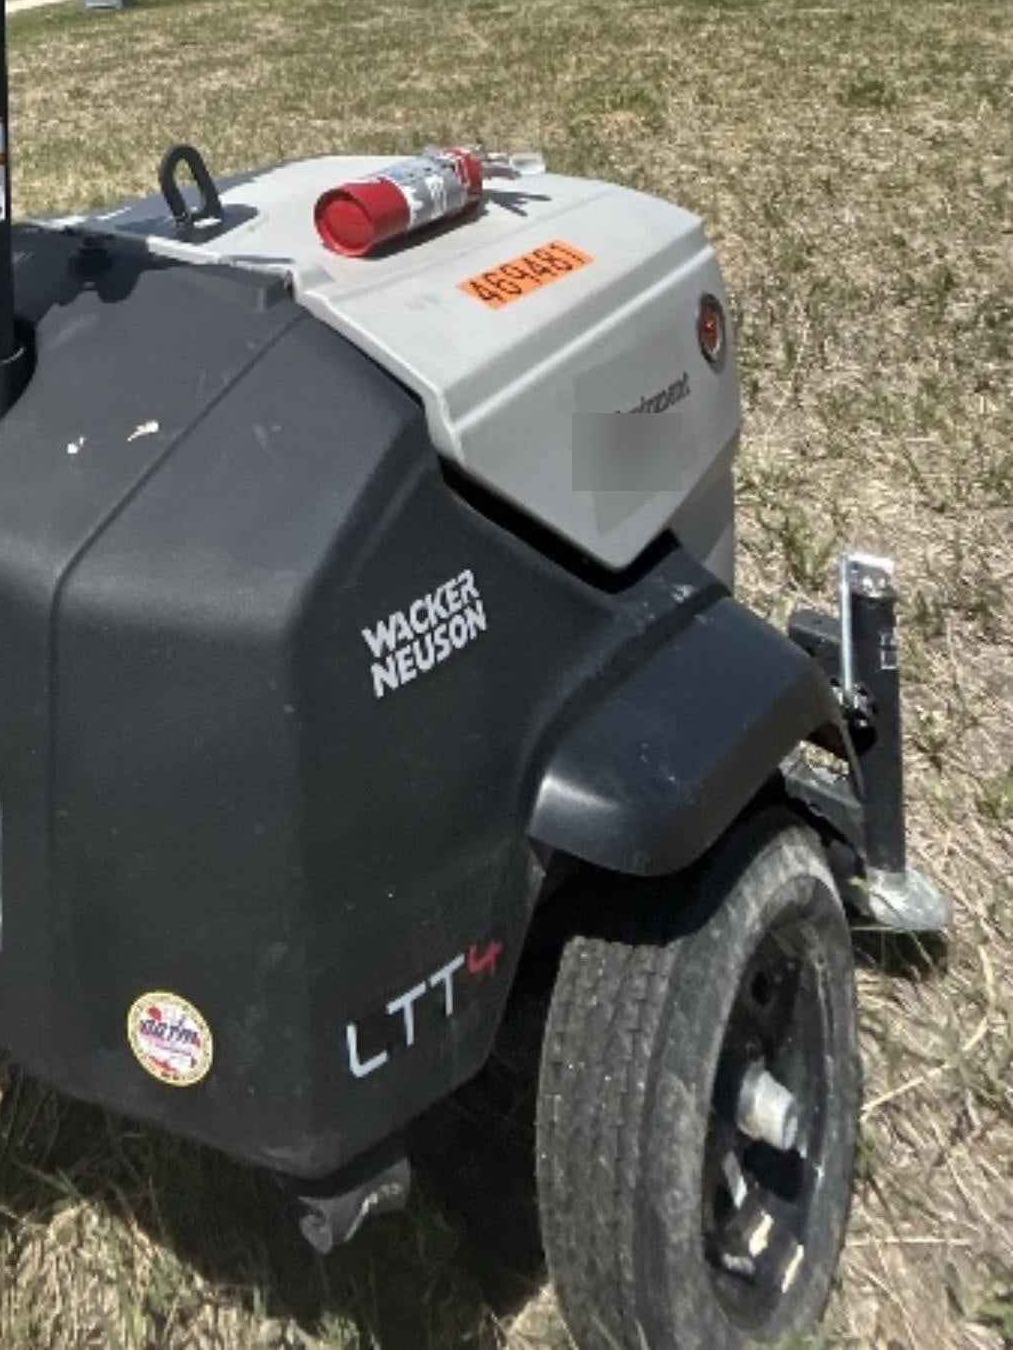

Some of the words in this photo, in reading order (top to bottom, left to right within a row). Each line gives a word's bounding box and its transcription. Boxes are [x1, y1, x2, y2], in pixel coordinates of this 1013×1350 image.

[468, 242, 586, 303] 469481
[361, 568, 481, 658] WACKER
[370, 602, 488, 699] NEUSON
